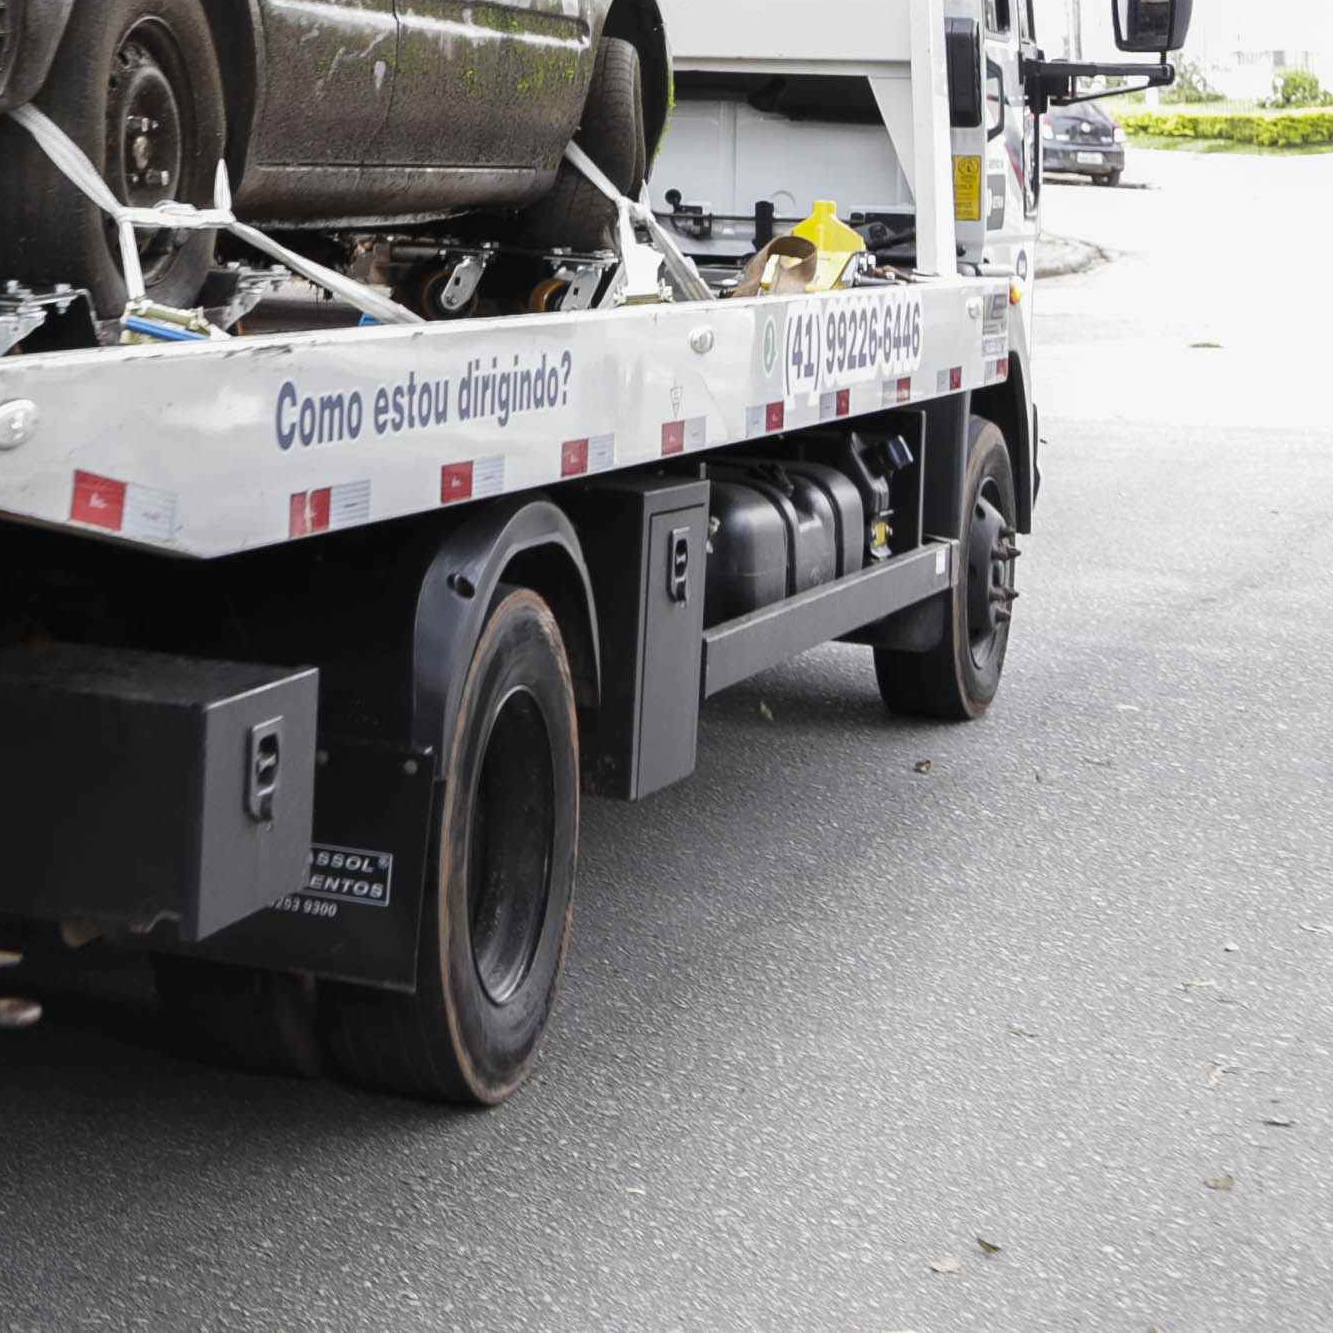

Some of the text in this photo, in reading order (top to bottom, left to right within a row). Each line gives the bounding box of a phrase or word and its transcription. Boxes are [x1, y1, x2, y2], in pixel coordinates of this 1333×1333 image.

[785, 313, 821, 395] (41)
[826, 301, 921, 374] 99226-6446
[275, 350, 572, 450] Como estou dirigindo?
[309, 850, 374, 873] SSOL
[309, 874, 384, 899] ENTOS
